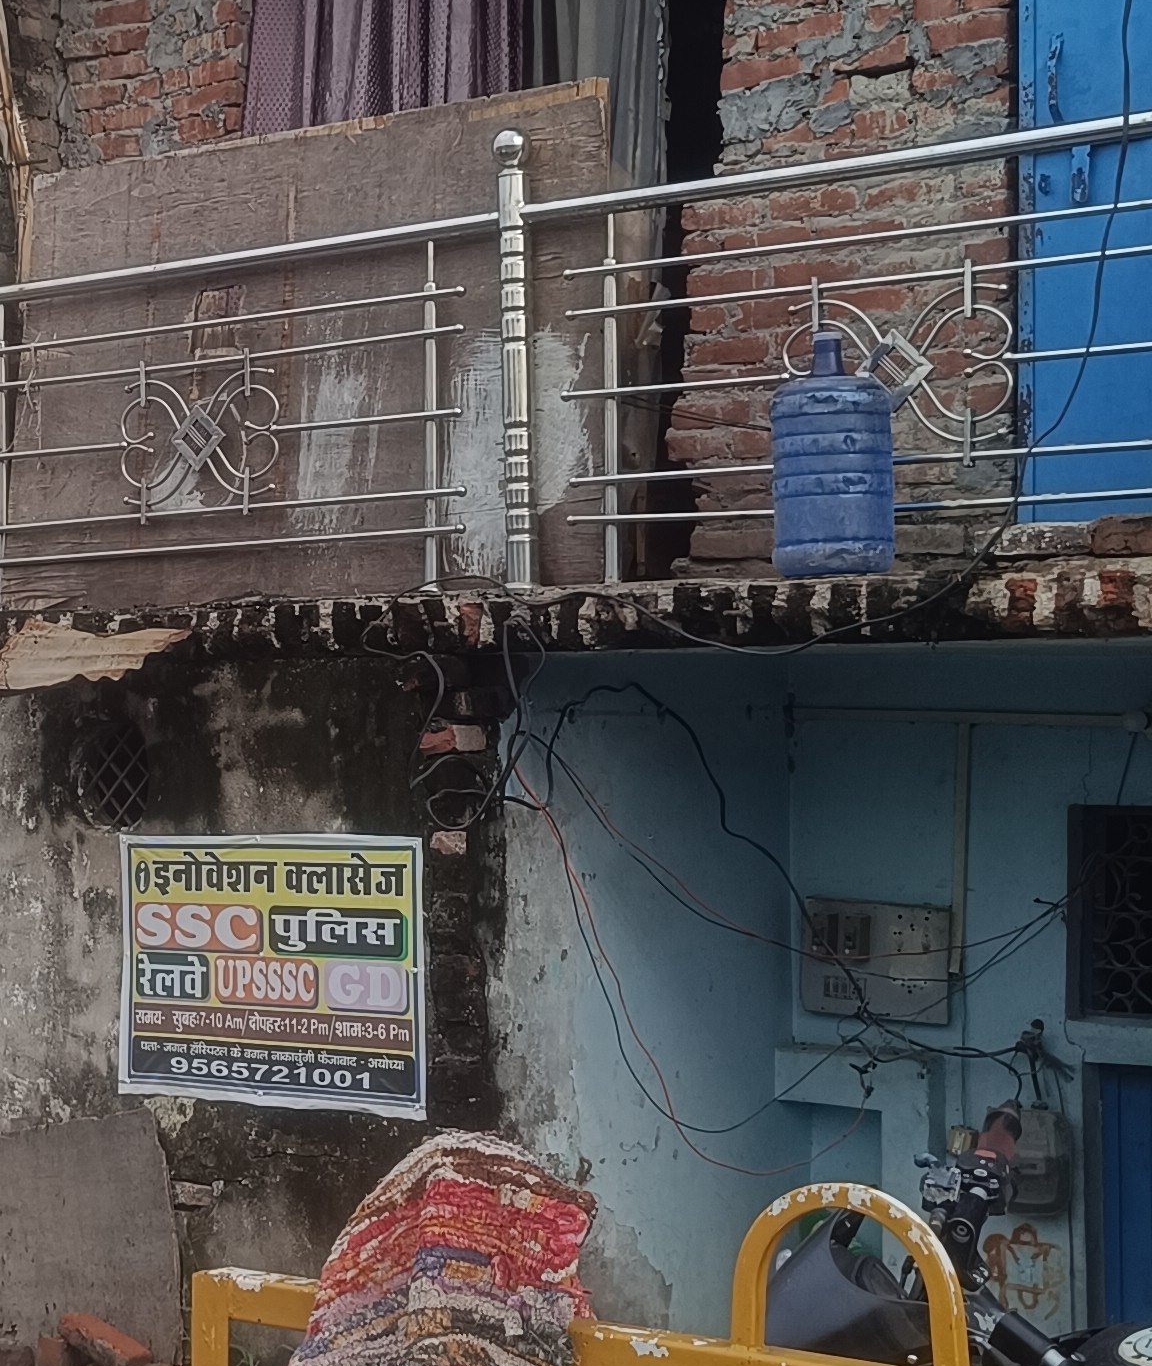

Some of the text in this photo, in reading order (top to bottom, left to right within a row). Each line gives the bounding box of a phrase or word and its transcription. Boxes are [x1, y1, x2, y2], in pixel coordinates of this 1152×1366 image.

[152, 851, 408, 897] इनोवेशन क्लासेज
[136, 903, 258, 950] SSC
[270, 908, 401, 952] पुलिस
[138, 953, 207, 998] रेलवे
[215, 958, 315, 1002] UPSSSC
[328, 964, 402, 1007] GD
[389, 1024, 410, 1042] Pm
[163, 1042, 187, 1054] जगत
[230, 1044, 242, 1058] के
[367, 1055, 405, 1071] अयोध्या
[170, 1056, 371, 1089] 9565721001
